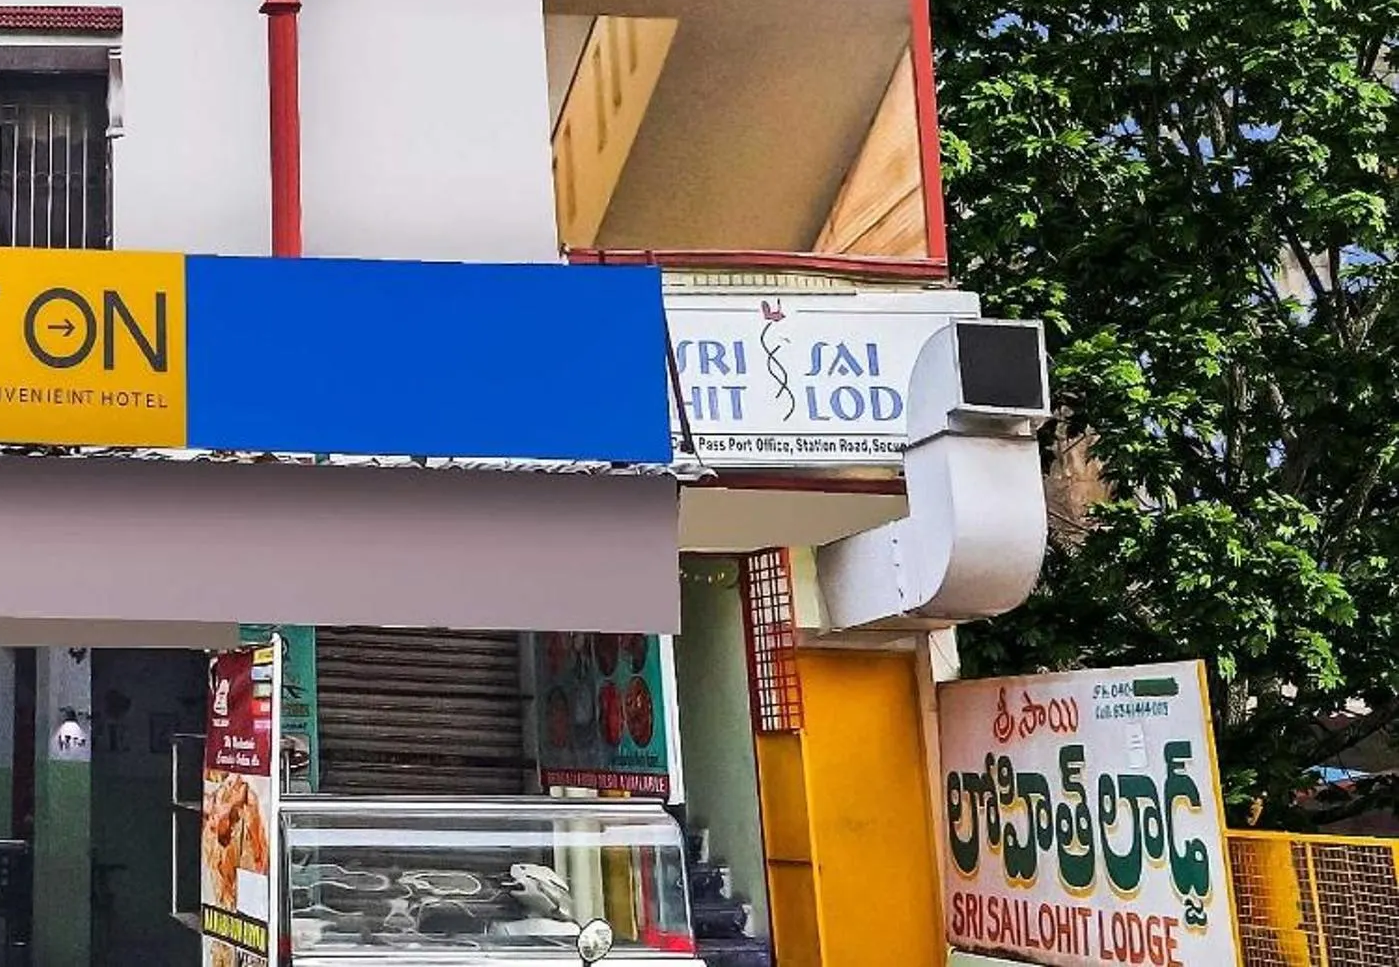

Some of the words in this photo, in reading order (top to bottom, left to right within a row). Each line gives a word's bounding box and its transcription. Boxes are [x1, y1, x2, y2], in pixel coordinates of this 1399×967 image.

[23, 287, 168, 373] ON
[676, 340, 747, 376] SRI
[804, 341, 881, 377] SAI
[101, 391, 169, 409] HOTEL
[805, 386, 904, 422] LOD
[699, 437, 727, 452] Pass
[728, 438, 753, 453] Port
[756, 438, 794, 455] Office,
[795, 439, 836, 453] Station
[952, 891, 984, 942] SRI
[986, 895, 1021, 947] SAI
[1023, 899, 1092, 957] LOHIT
[1098, 909, 1184, 967] LODGE
